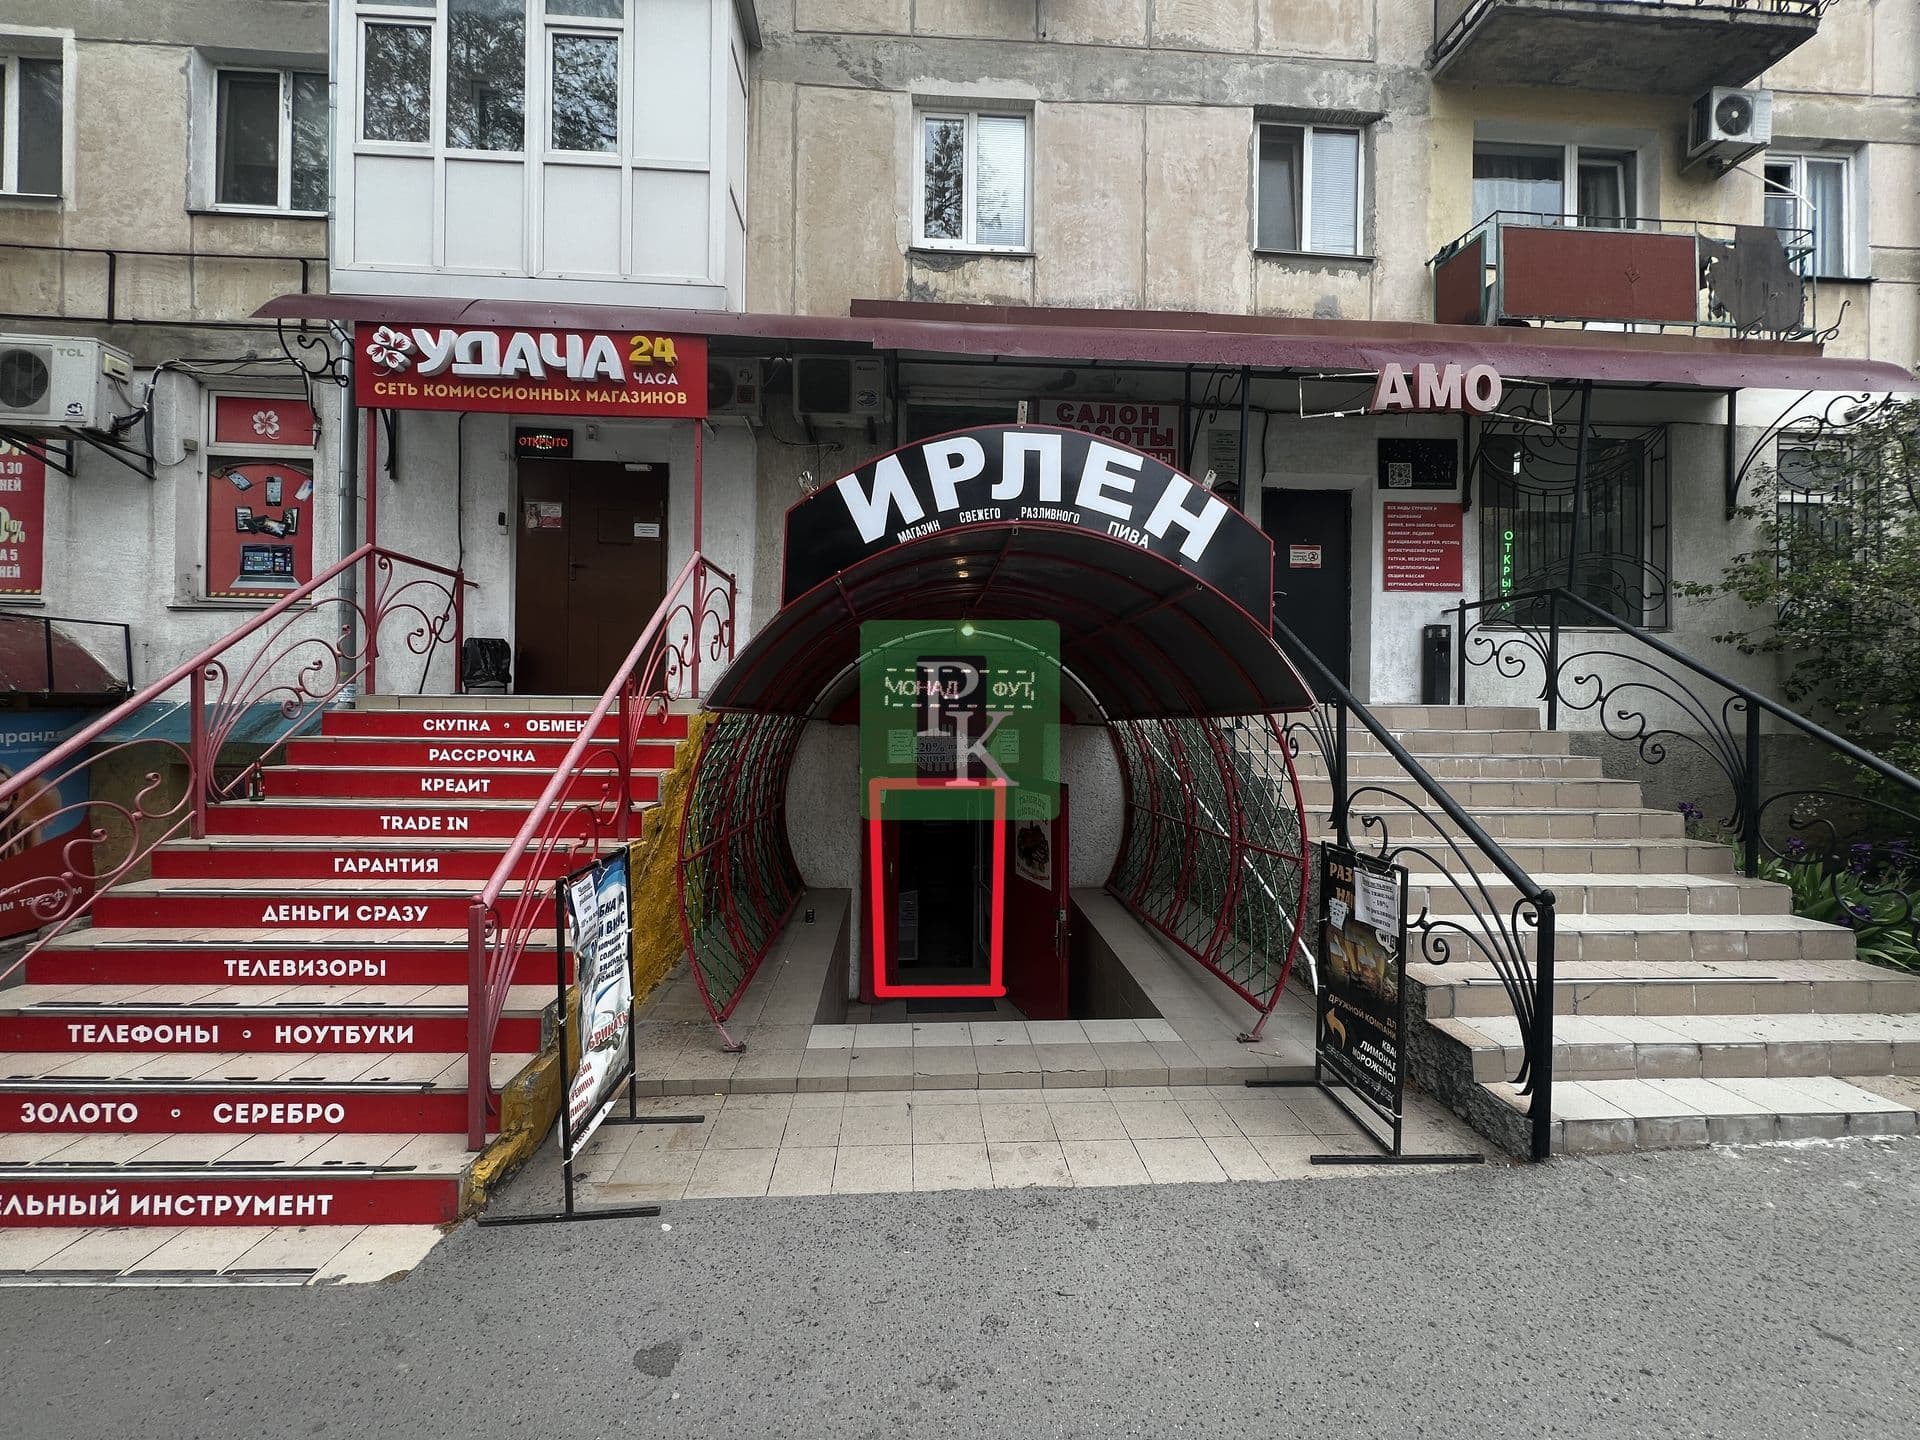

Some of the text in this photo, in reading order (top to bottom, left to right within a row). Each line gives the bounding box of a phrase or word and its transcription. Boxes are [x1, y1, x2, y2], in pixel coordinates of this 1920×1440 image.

[57, 347, 84, 358] TCL
[412, 328, 626, 383] УДАЧА
[628, 335, 679, 367] 24
[633, 371, 679, 386] ЧАСА
[1371, 363, 1503, 414] АМО
[374, 381, 688, 405] СЕТЬ КОМИССИОННЫХ МАГАЗИНОВ
[1056, 402, 1160, 426] САЛОН
[518, 436, 569, 448] ОТКРЫТО
[836, 431, 1229, 564] ИРЛЕН
[896, 506, 1150, 551] МАГАЗИН СВЕЖЕГО РАЗЛИВНОГО ПИВА
[423, 718, 491, 732] СКУПКА
[428, 748, 536, 763] РАССРОЧКА
[420, 778, 491, 794] КРЕДИТ
[380, 816, 469, 831] TRADE IN
[333, 857, 439, 873] ГАРАНТИЯ
[261, 905, 429, 924] ДЕНЬГИ СРАЗУ
[224, 959, 387, 978] ТЕЛЕВИЗОРЫ
[1328, 993, 1364, 1019] ДРУЖНОЙ
[67, 1023, 414, 1045] ТЕЛЕФОНЫ НОУТБУКИ
[1382, 1040, 1397, 1058] КВА
[20, 1102, 345, 1124] ЗОЛОТО СЕРЕБРО
[0, 1189, 334, 1217] ЛЬНЫЙ ИНСТРУМЕНТ
